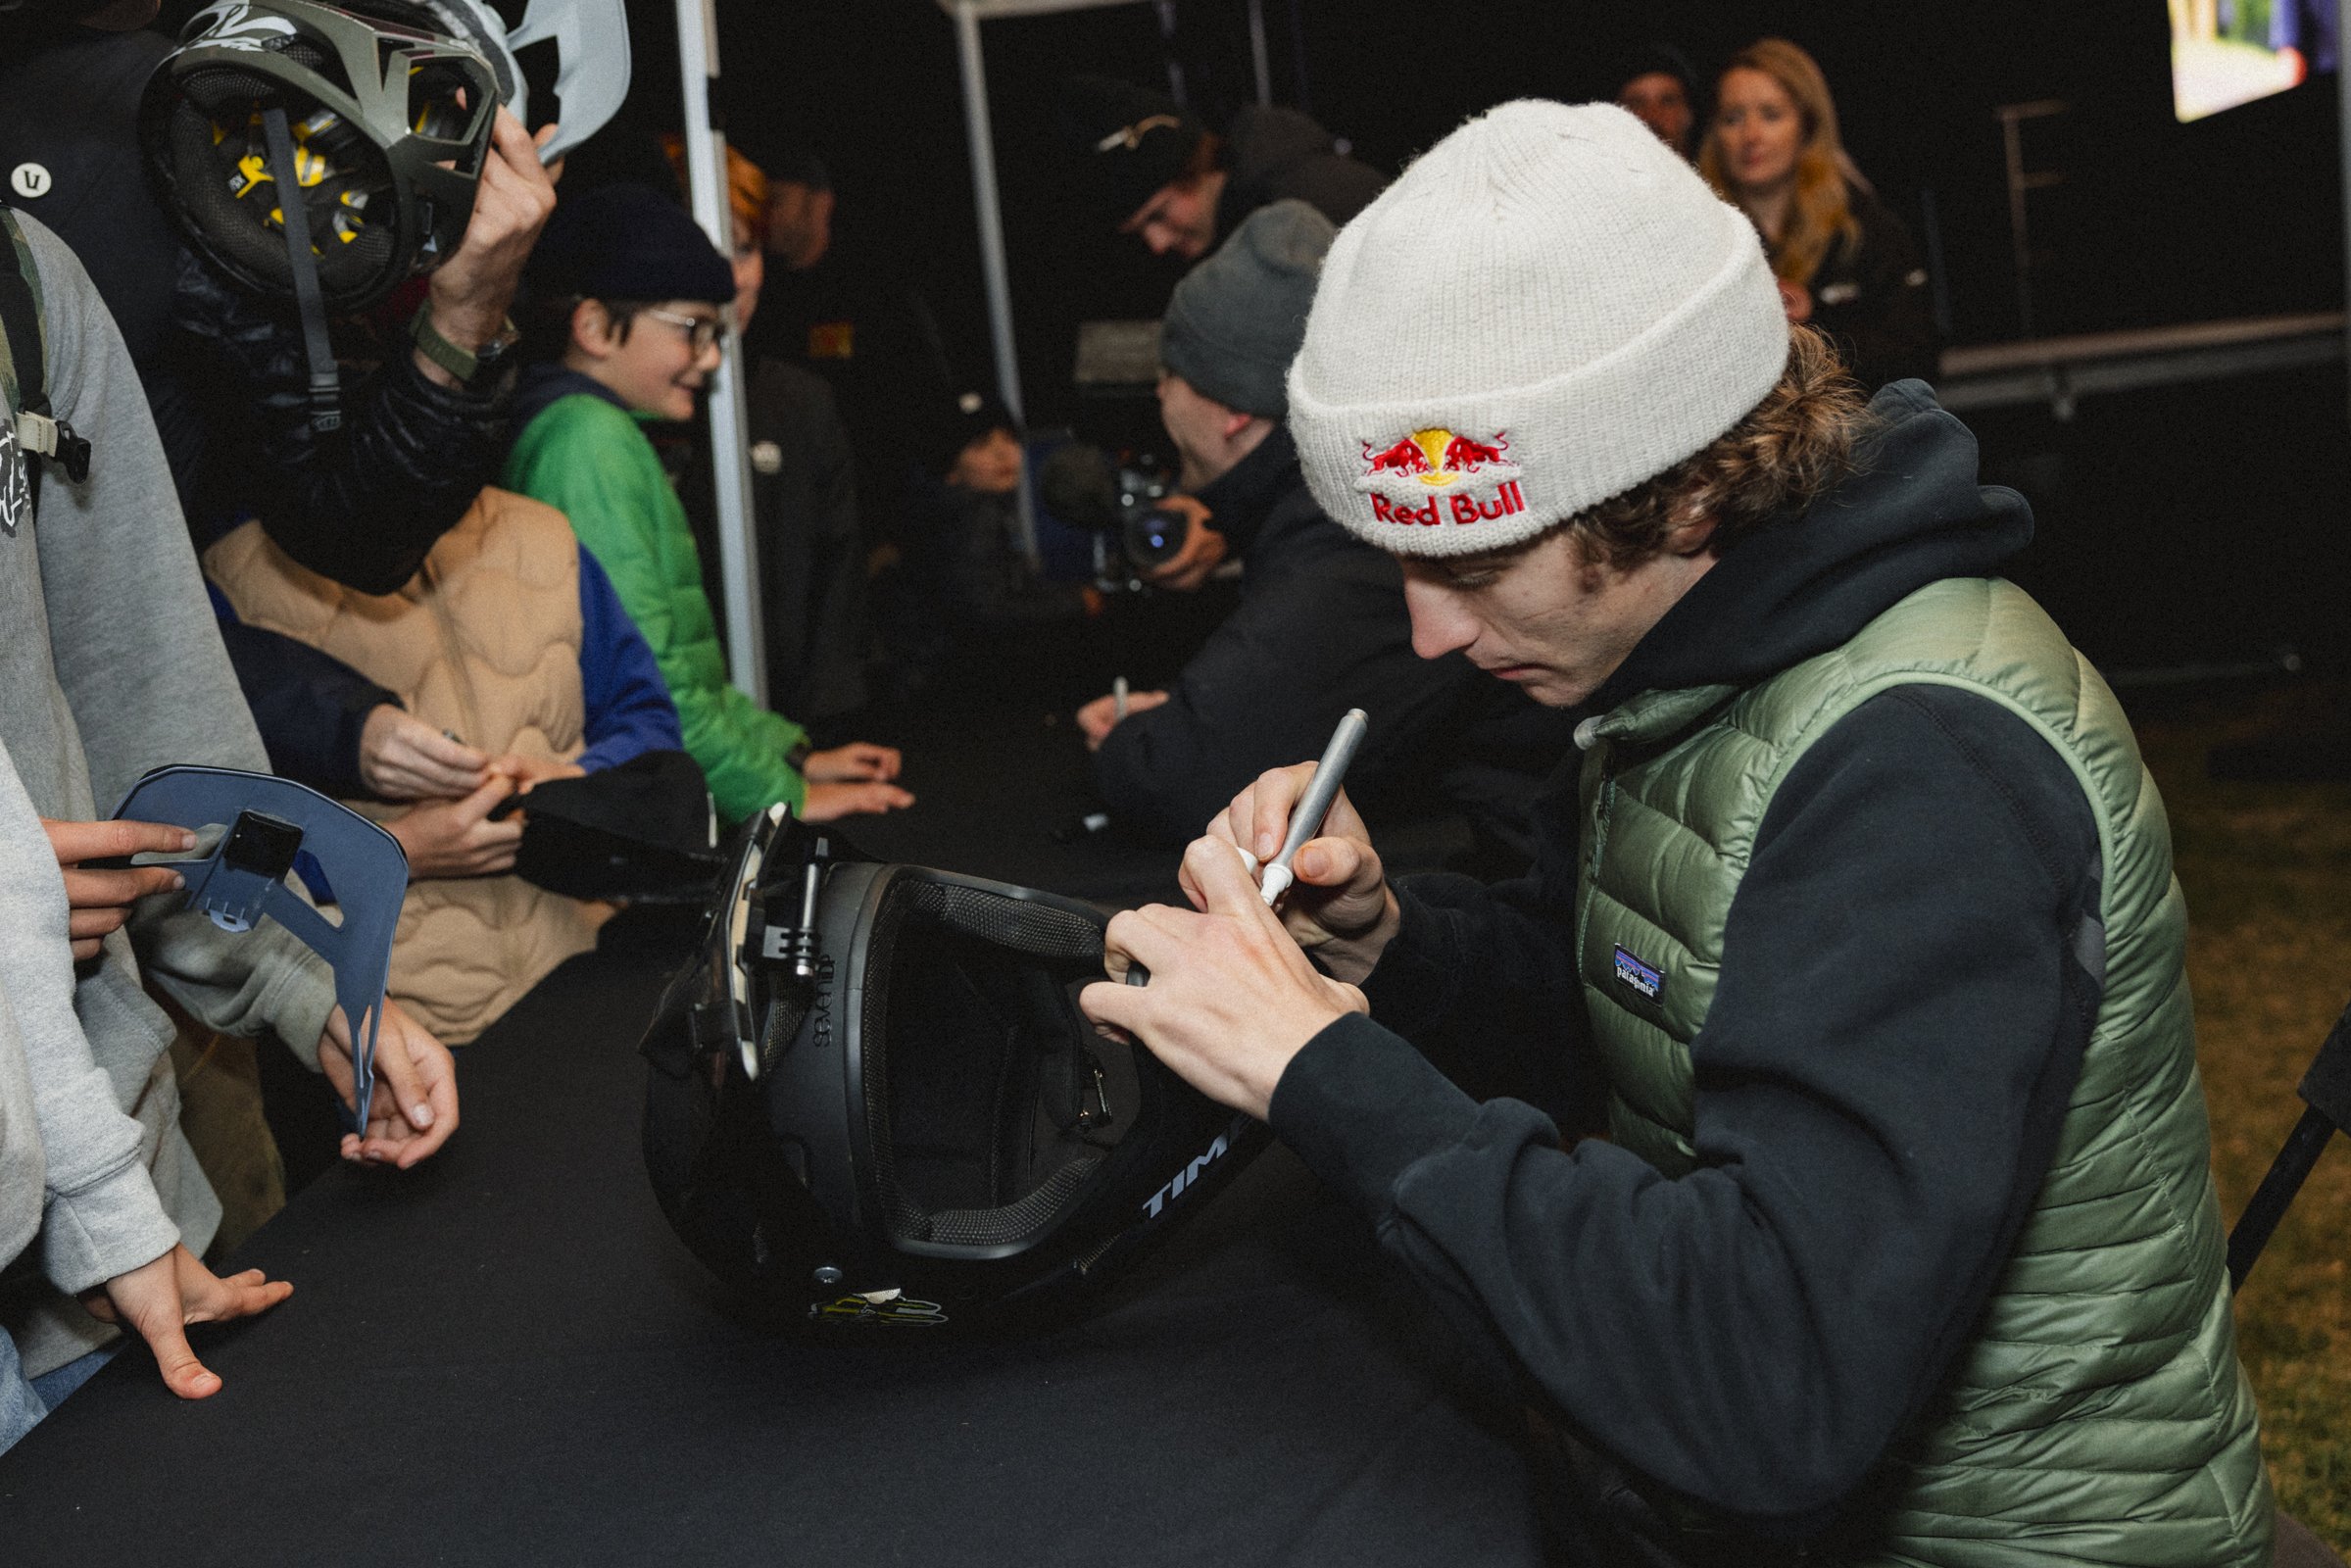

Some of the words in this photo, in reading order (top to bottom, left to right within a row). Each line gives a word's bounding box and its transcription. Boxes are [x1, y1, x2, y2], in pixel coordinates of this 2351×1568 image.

[1370, 492, 1441, 526] Red
[1448, 480, 1525, 524] Bull
[1617, 966, 1654, 998] patagonia
[1142, 1119, 1243, 1219] TIM
